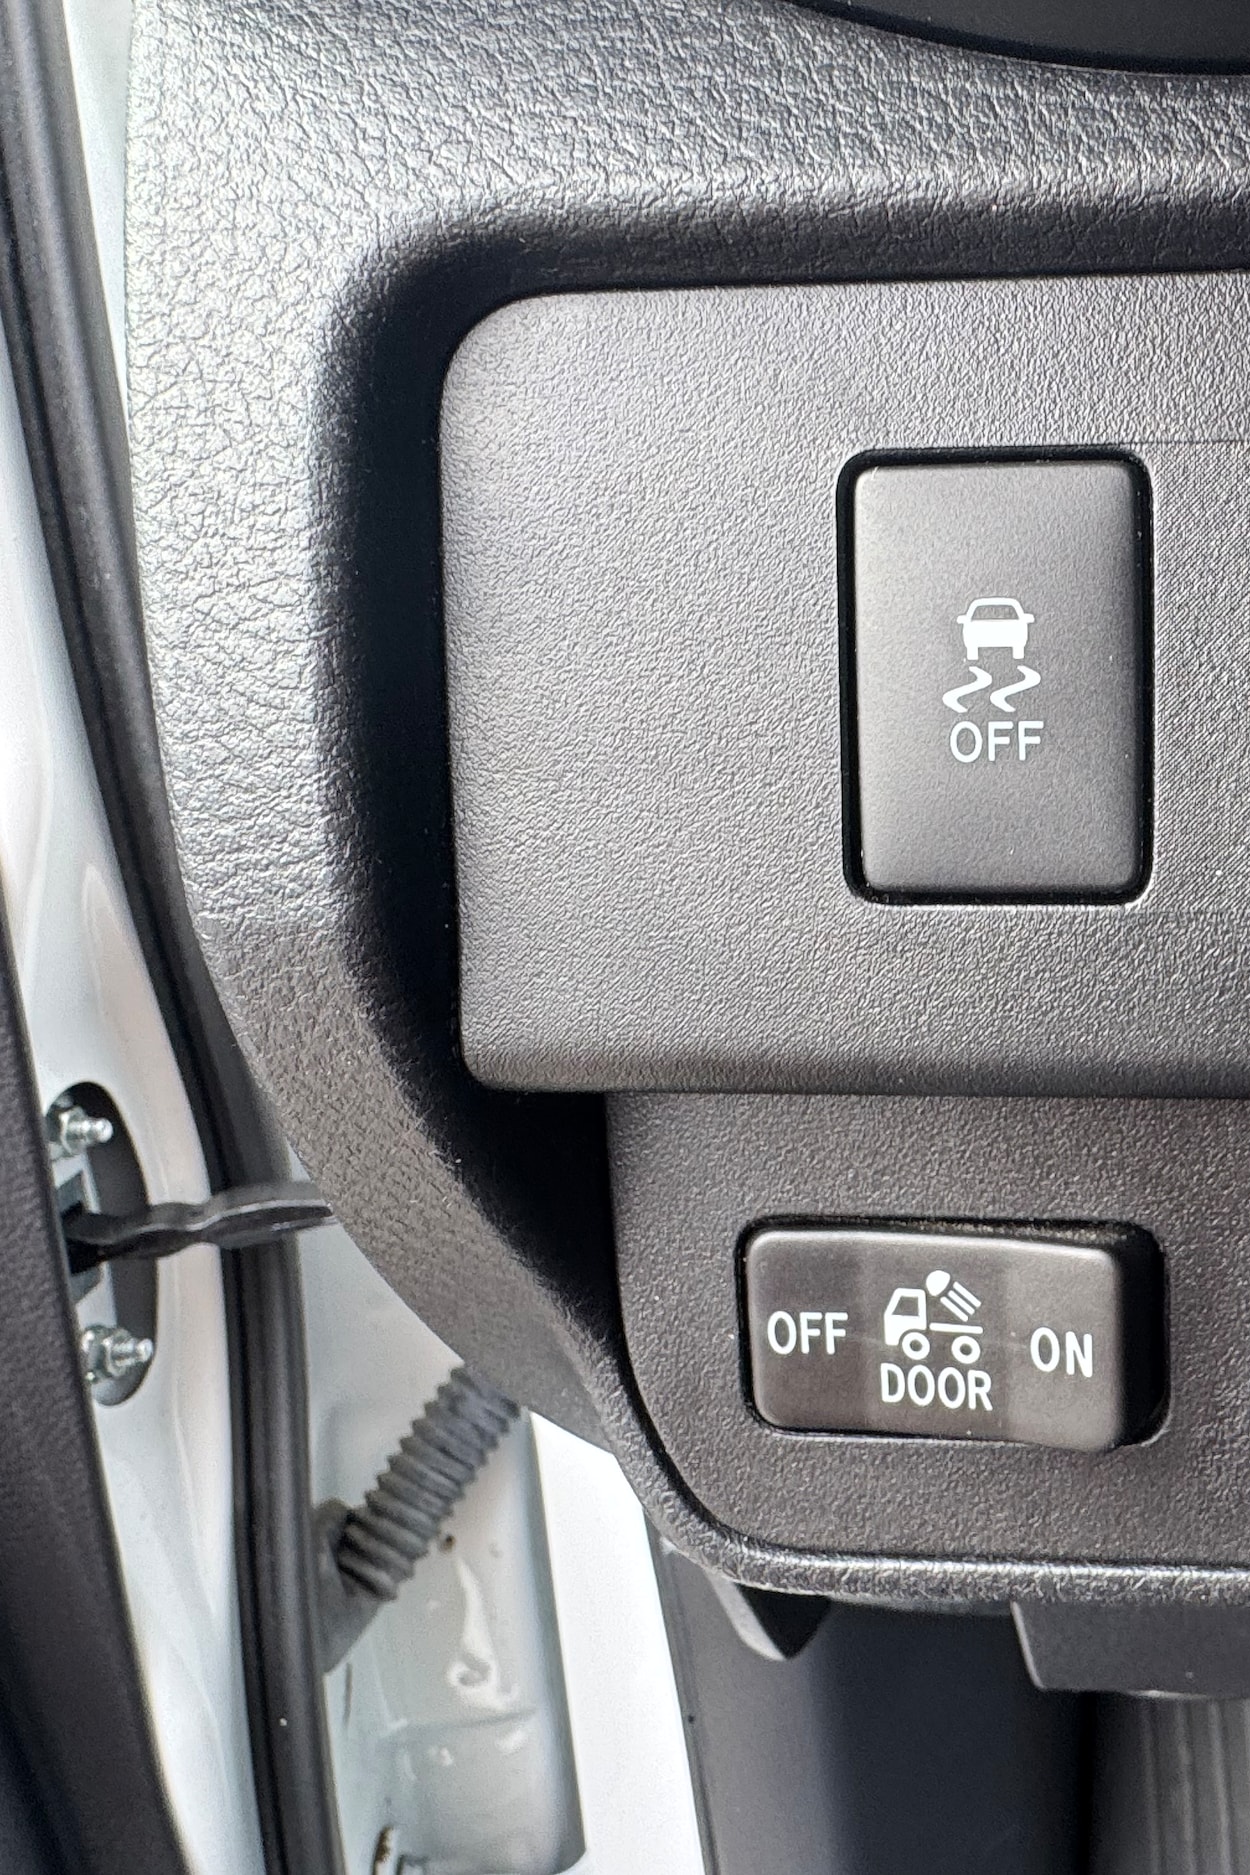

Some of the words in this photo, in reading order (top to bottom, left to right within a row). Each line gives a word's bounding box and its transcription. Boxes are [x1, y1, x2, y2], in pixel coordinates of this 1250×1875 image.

[949, 720, 1044, 763] OFF
[767, 1310, 849, 1355] OFF
[1030, 1327, 1093, 1378] ON
[880, 1362, 993, 1411] DOOR
